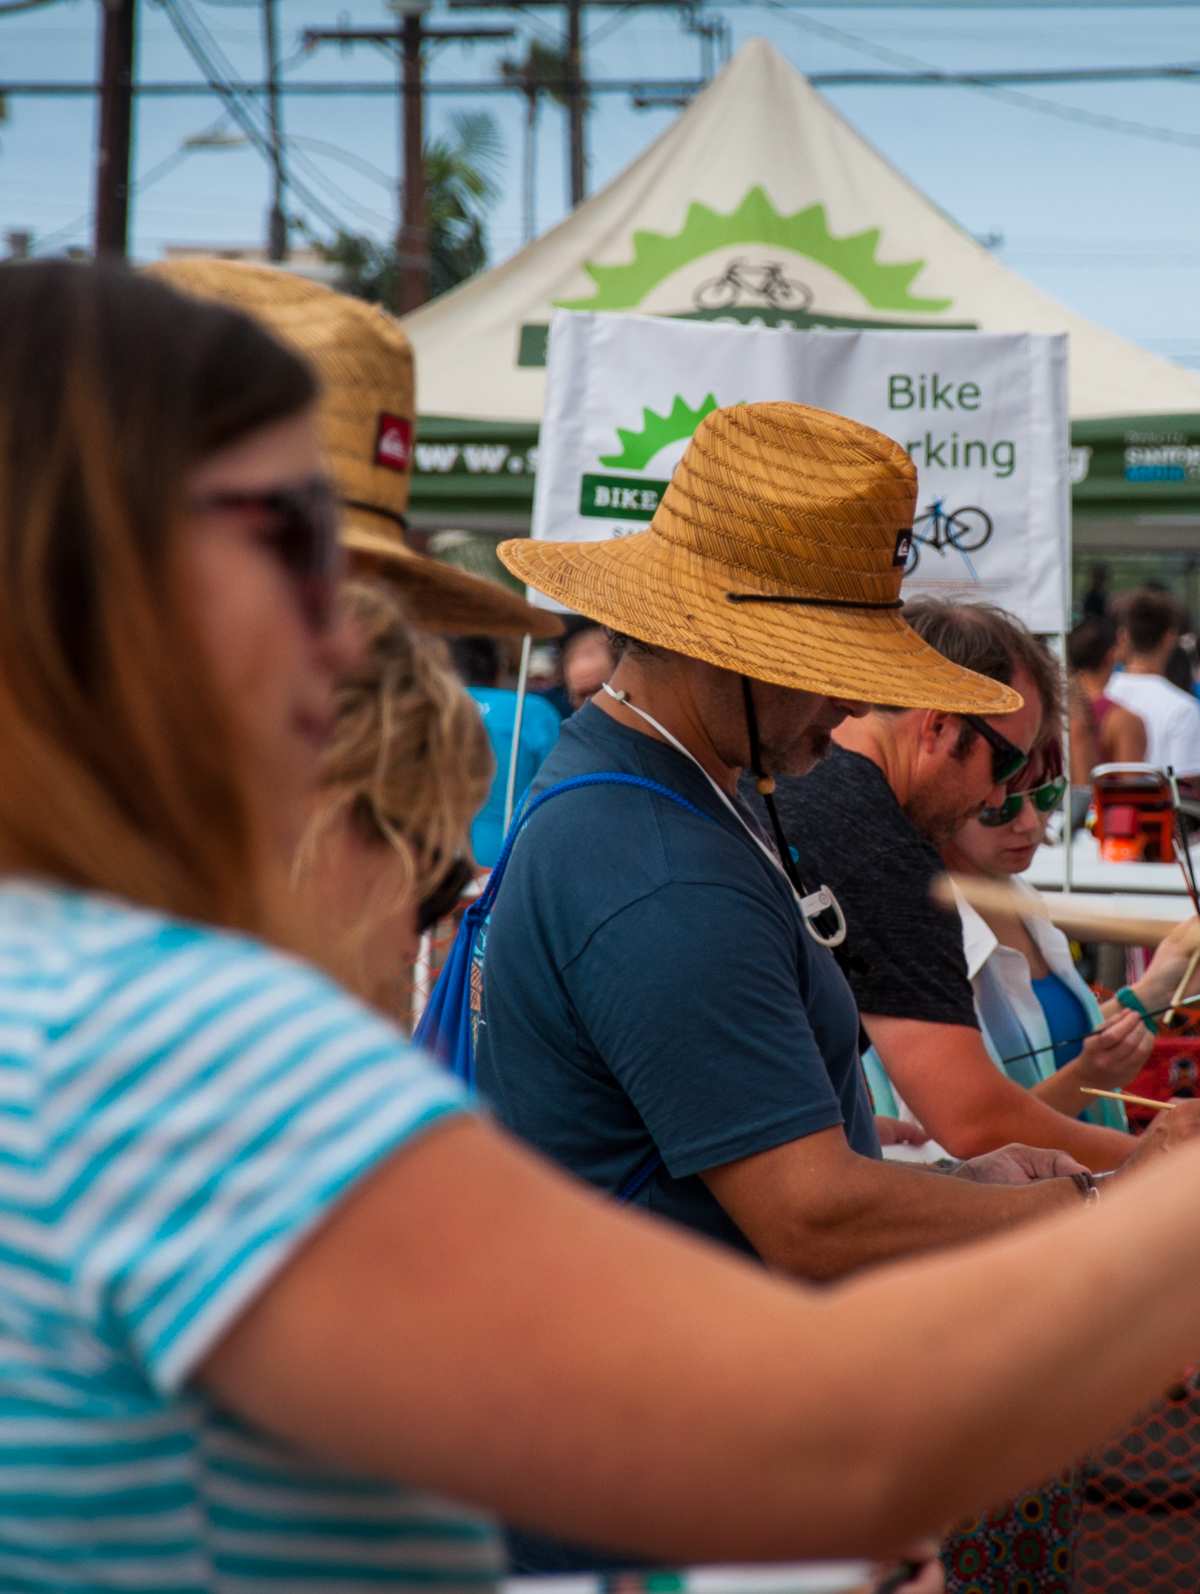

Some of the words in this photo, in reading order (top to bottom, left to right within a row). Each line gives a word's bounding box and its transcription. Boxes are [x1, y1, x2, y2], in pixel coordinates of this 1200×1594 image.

[888, 373, 982, 411] Bike
[906, 431, 1016, 478] rking
[594, 485, 659, 511] BIKE
